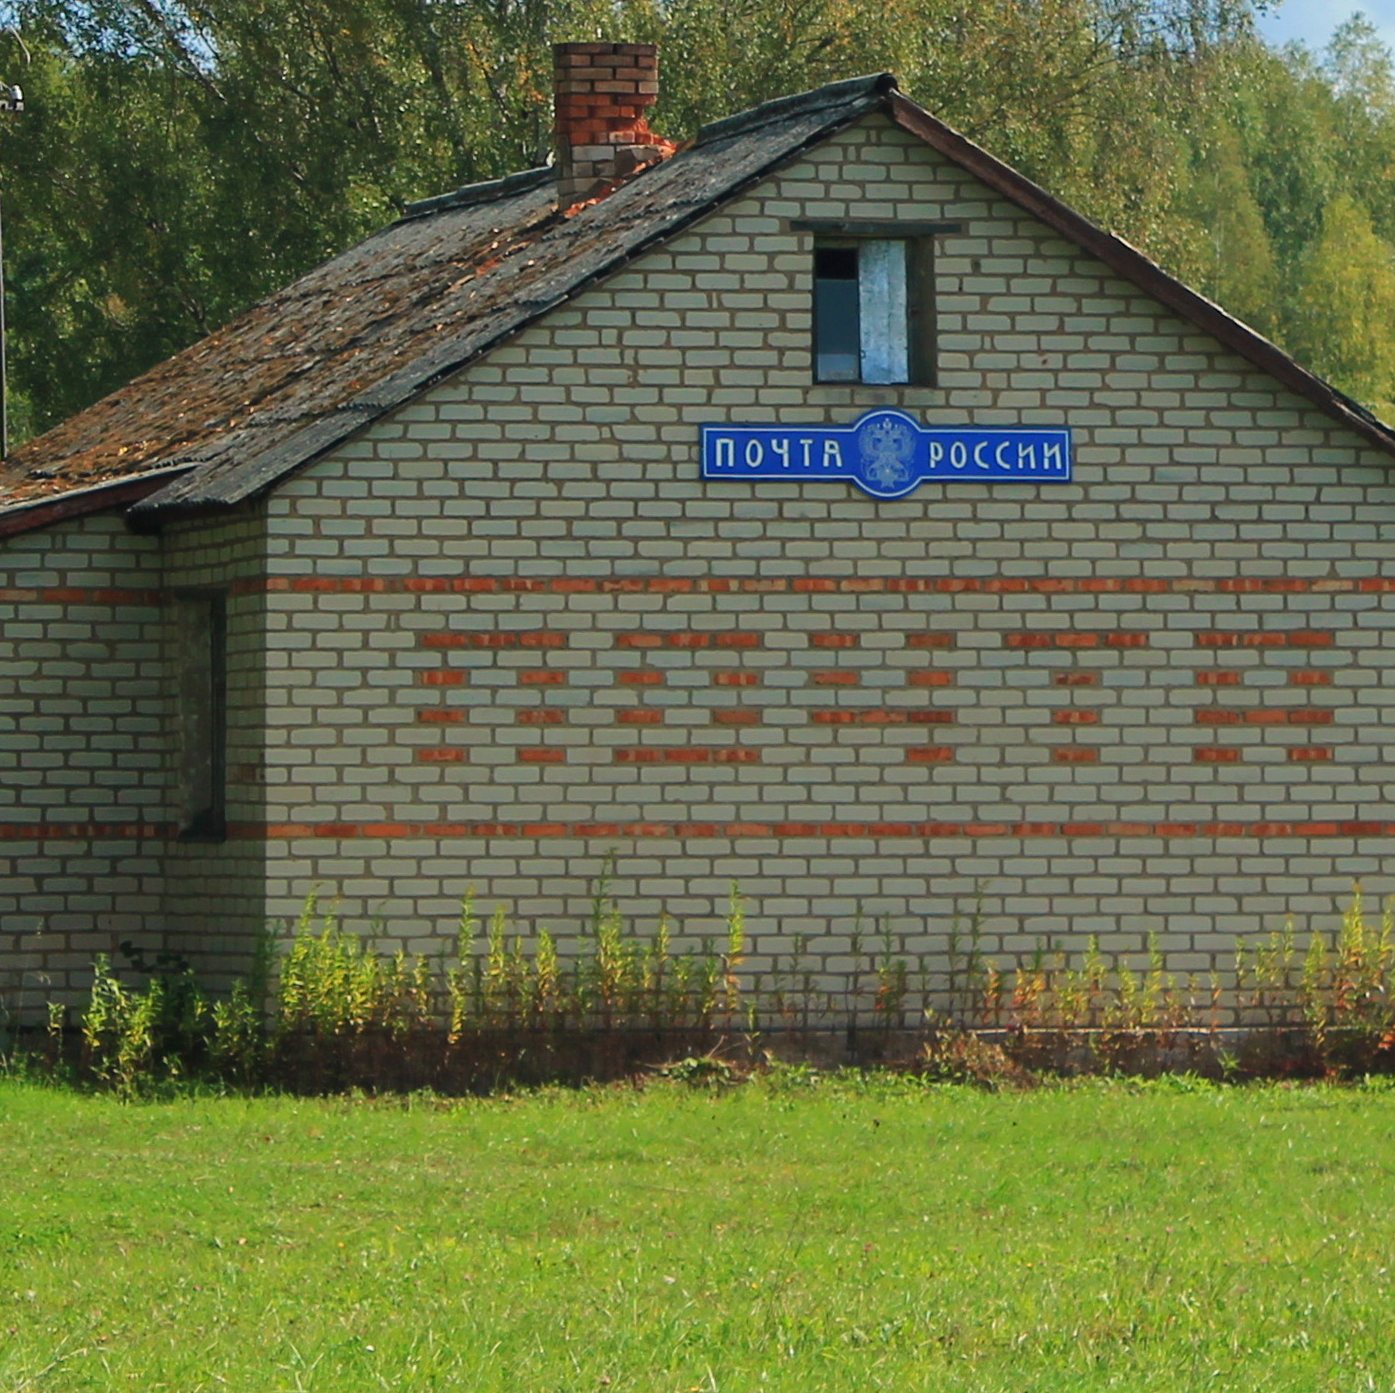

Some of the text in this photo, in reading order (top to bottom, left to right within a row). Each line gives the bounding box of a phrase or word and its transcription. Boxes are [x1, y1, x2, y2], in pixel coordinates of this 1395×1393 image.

[714, 437, 1063, 470] ПОЧТА РОССИИ
[416, 633, 1333, 763] ПОЧТА
